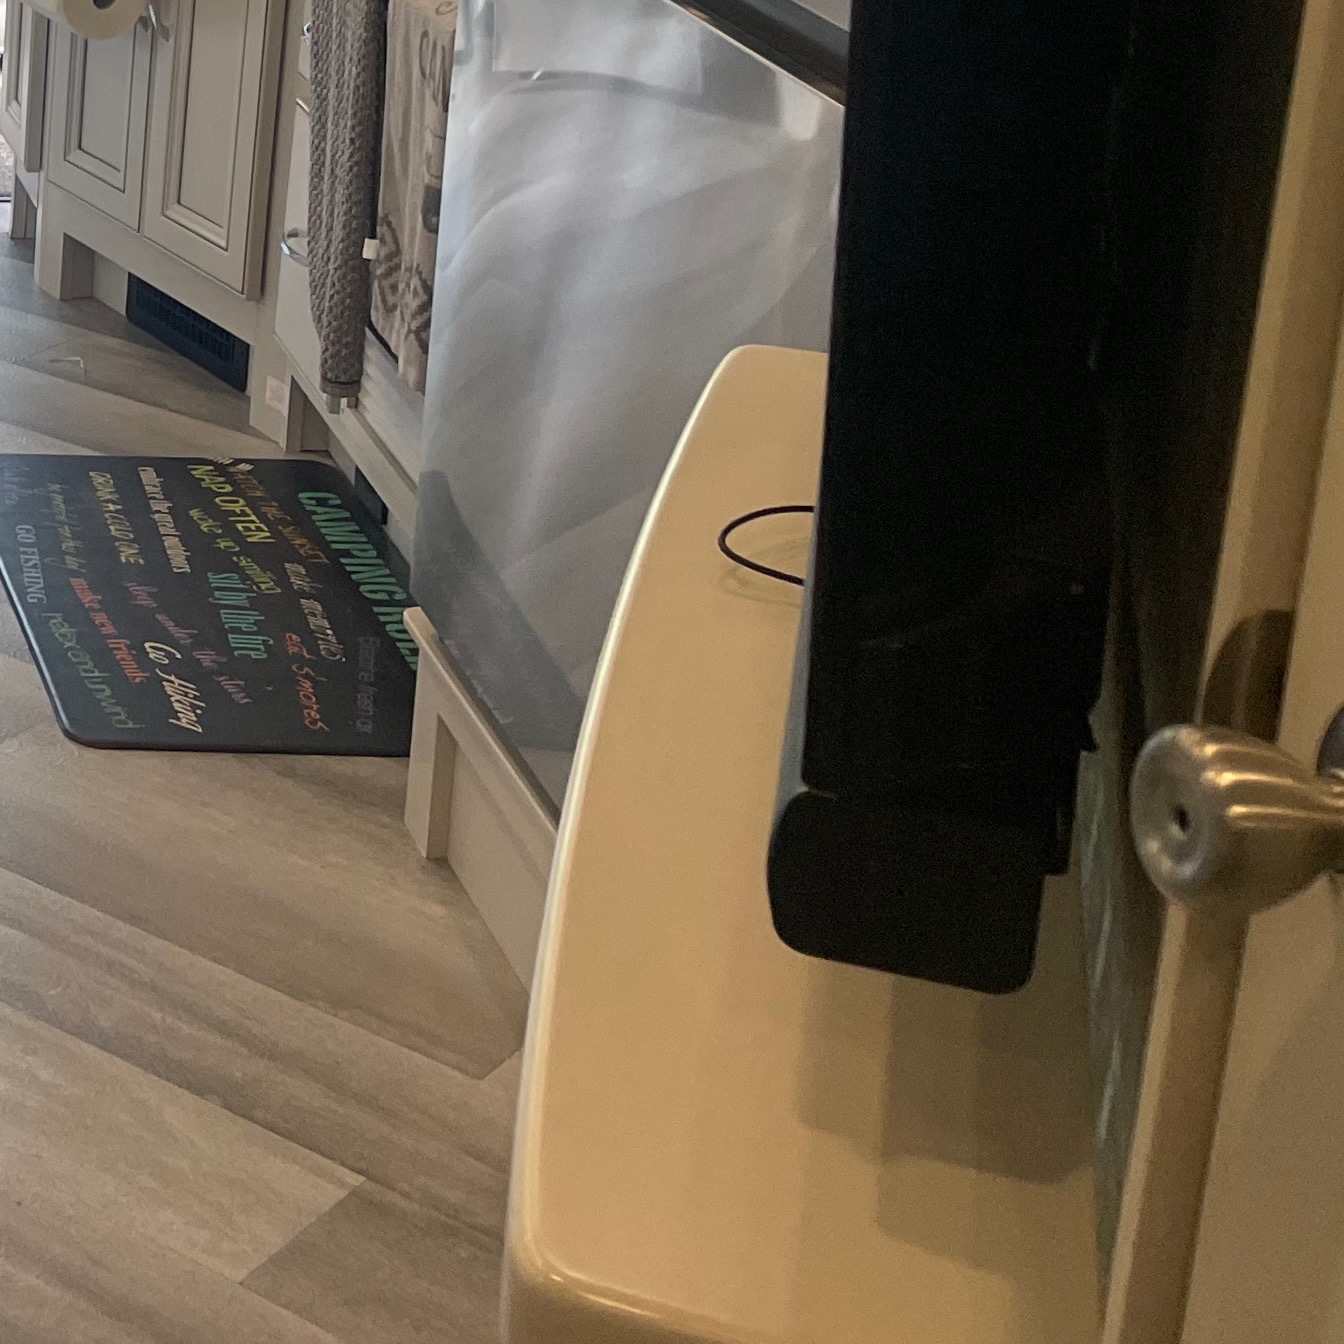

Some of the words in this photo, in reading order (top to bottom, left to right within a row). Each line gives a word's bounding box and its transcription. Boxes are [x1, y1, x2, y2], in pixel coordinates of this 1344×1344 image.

[88, 471, 121, 501] DRINK
[137, 466, 165, 499] embrace
[102, 502, 124, 511] A
[187, 465, 234, 493] NAP
[214, 496, 277, 543] OFTEN
[15, 524, 37, 543] GO
[104, 512, 135, 540] COLD
[150, 513, 182, 536] great
[114, 541, 145, 565] ONE
[162, 536, 192, 573] outdoors
[188, 507, 222, 534] wake
[215, 537, 241, 552] up
[231, 555, 282, 594] smiling
[297, 491, 408, 601] CAMPING
[18, 546, 48, 604] FISHING
[207, 571, 252, 588] sit
[207, 591, 257, 607] by
[41, 612, 81, 649] relax
[69, 577, 103, 609] make
[89, 611, 119, 635] new
[105, 638, 150, 685] friends
[220, 609, 265, 632] the
[144, 641, 182, 665] Go
[227, 632, 274, 660] fire
[285, 632, 318, 661] eat
[66, 650, 112, 677] and
[84, 677, 146, 729] unwind
[155, 667, 207, 734] Hiking
